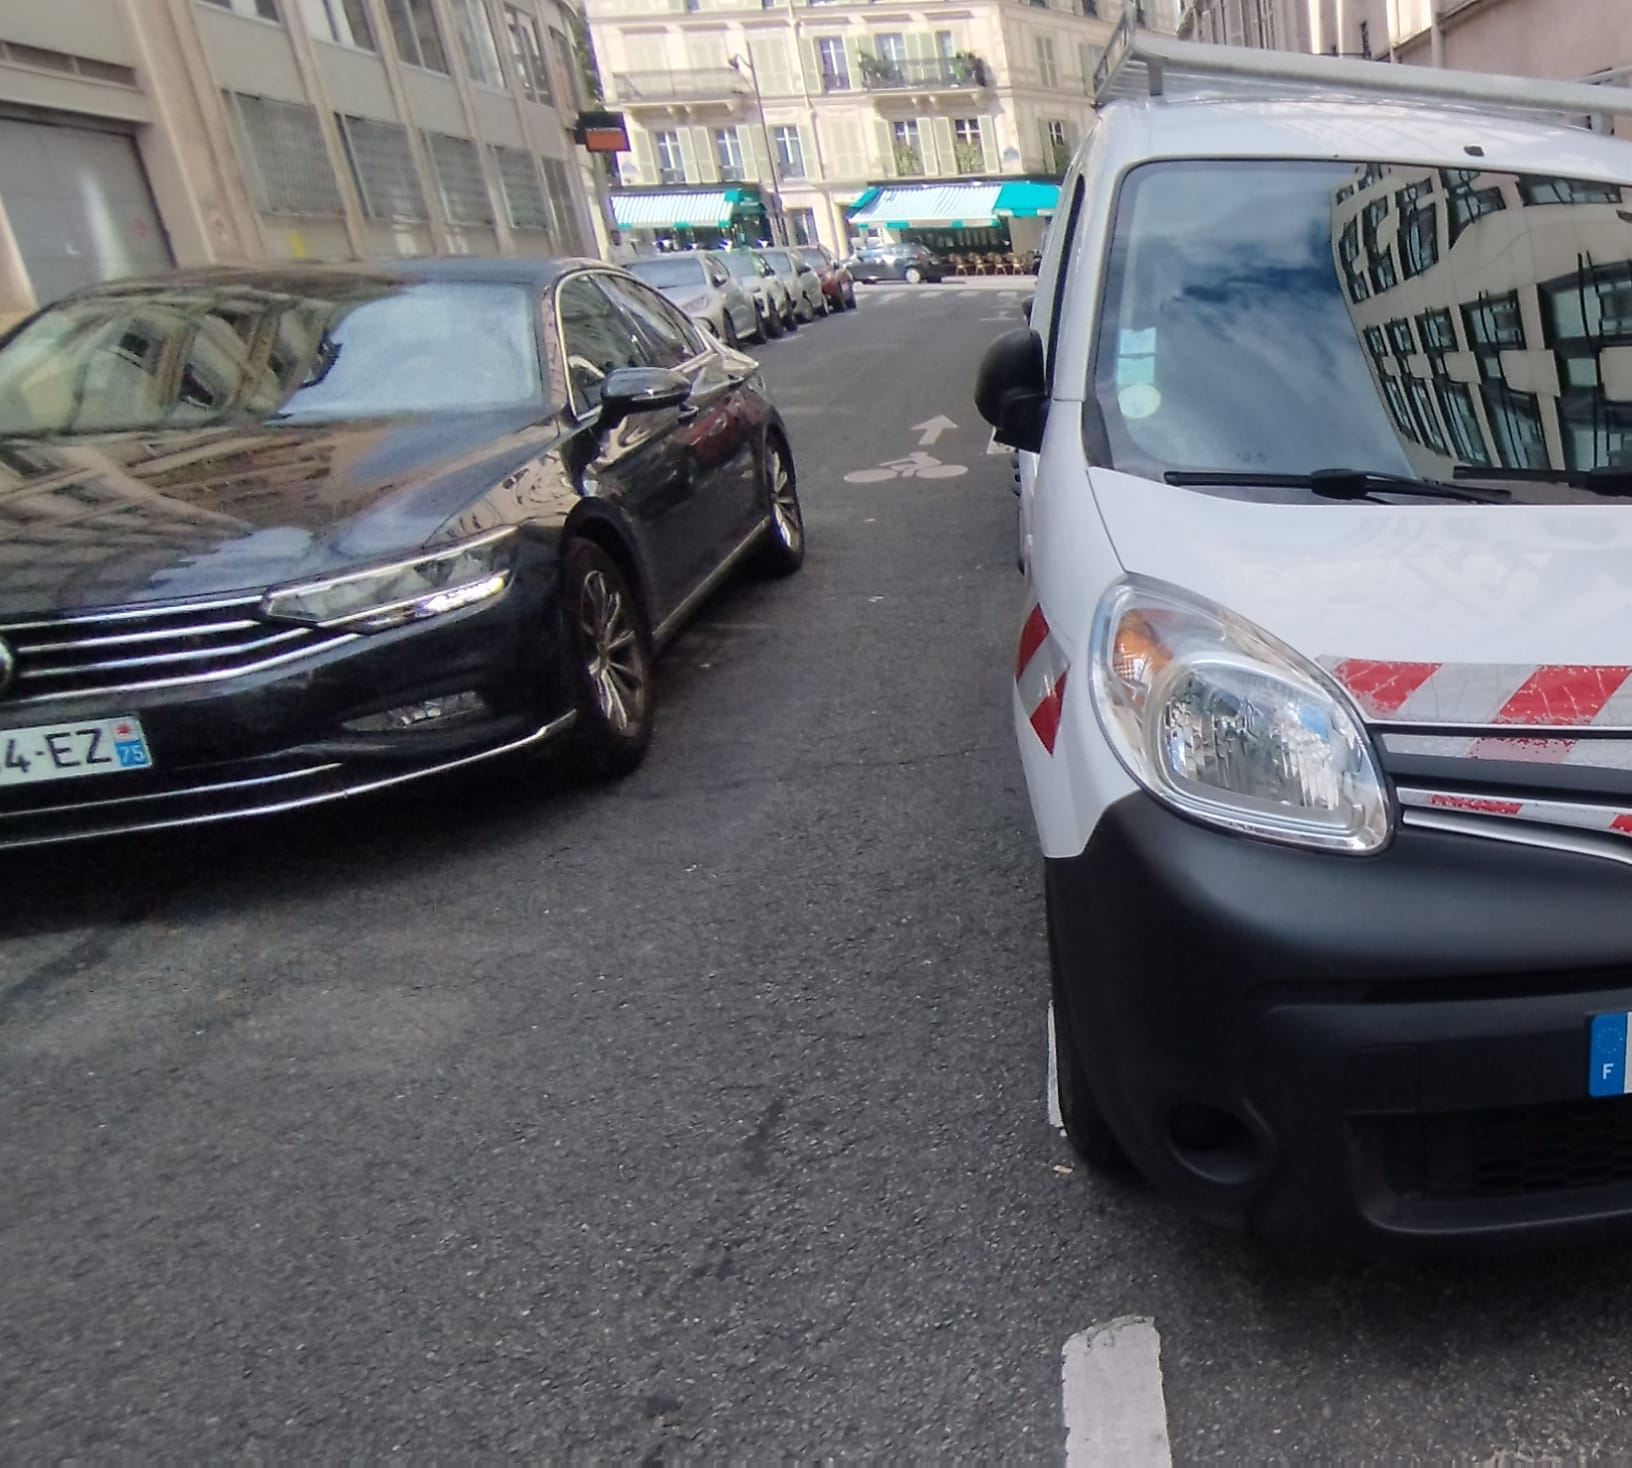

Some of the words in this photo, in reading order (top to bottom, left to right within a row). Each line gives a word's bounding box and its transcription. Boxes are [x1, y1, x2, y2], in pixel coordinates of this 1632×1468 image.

[0, 728, 112, 774] 4-EZ
[119, 744, 145, 763] 75
[1602, 1063, 1614, 1080] F
